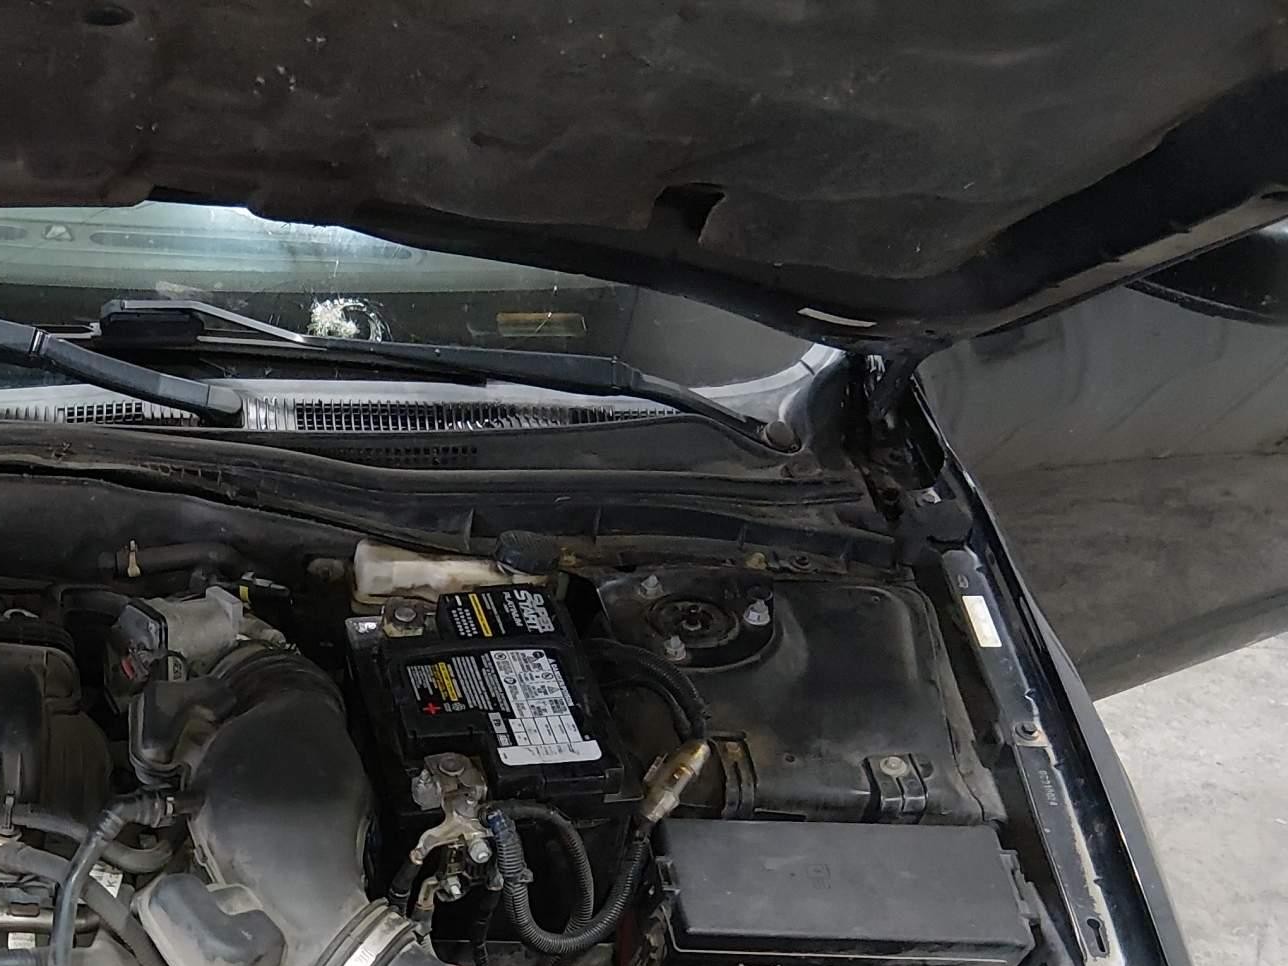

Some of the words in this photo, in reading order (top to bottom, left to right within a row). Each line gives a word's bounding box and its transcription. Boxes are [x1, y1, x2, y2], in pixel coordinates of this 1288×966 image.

[502, 592, 524, 627] PLATINUM
[512, 590, 540, 632] START
[532, 594, 555, 632] SUPER
